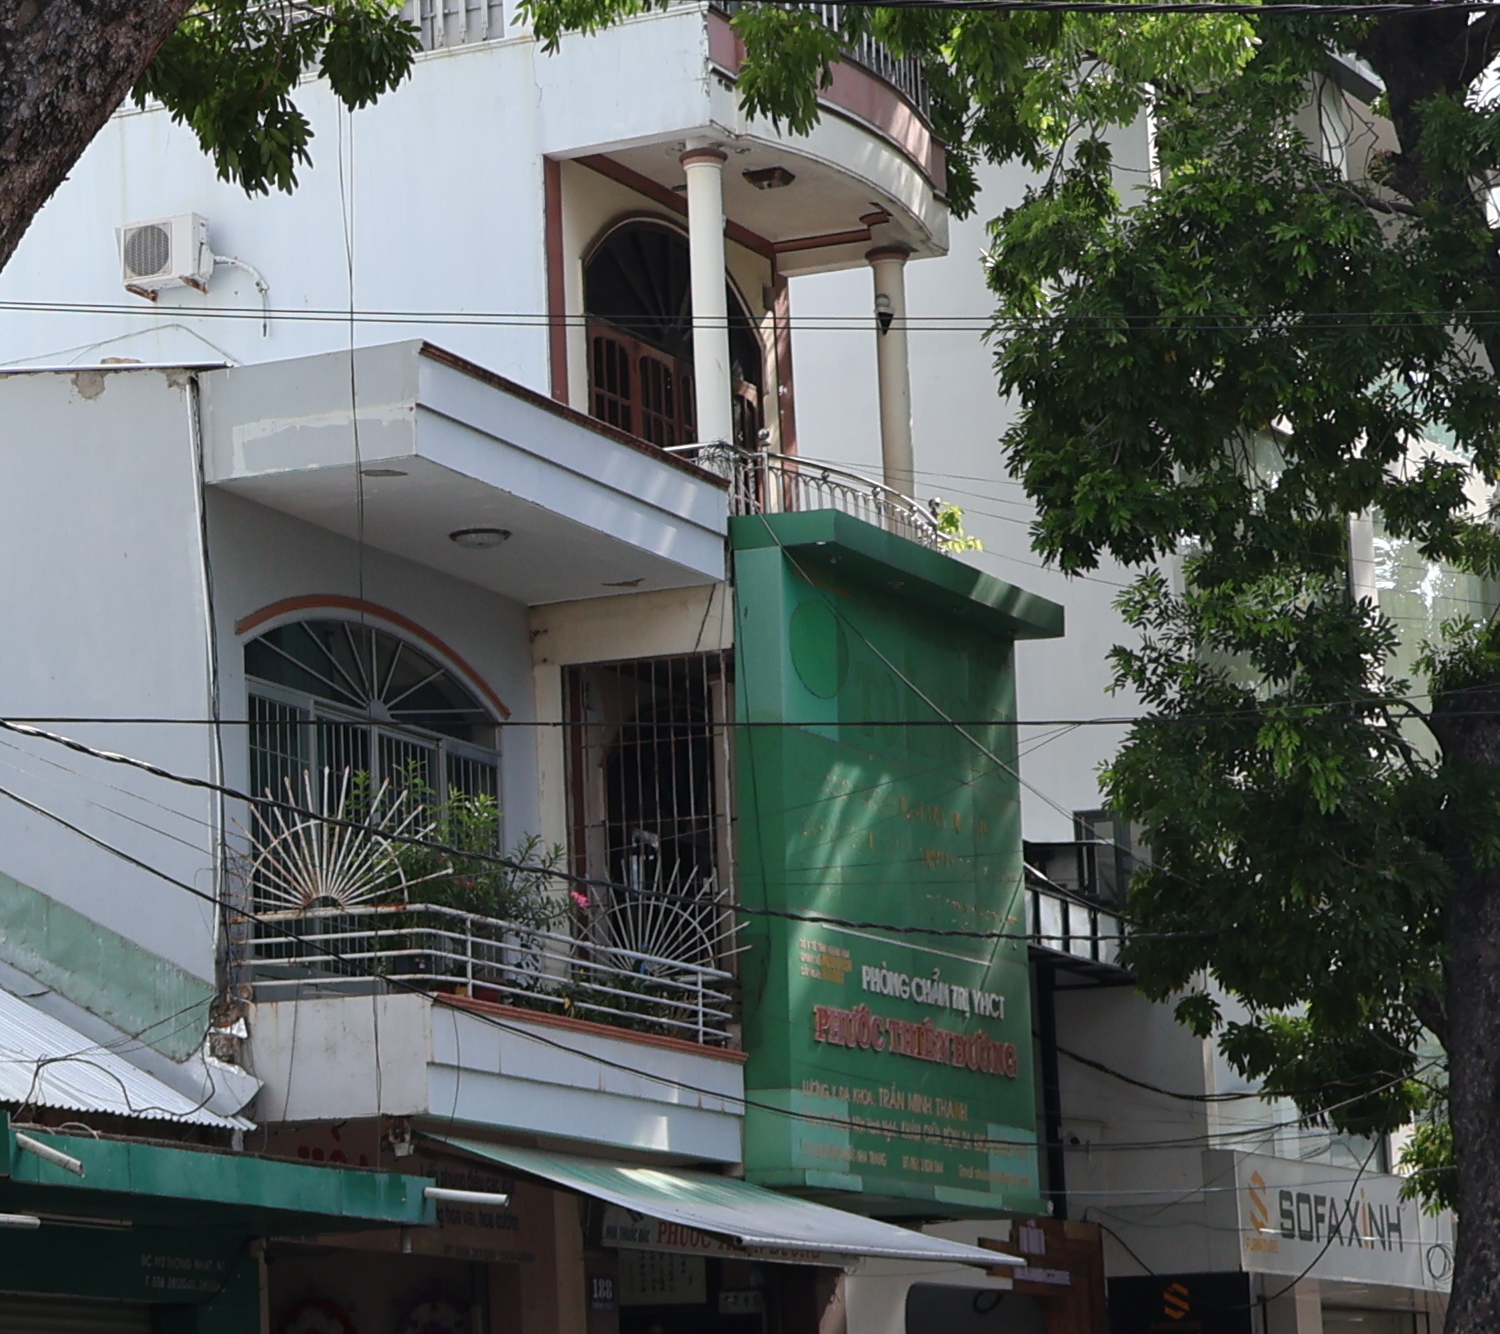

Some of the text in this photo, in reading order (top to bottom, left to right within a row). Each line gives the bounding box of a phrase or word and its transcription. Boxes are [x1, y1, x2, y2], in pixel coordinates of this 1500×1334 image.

[862, 962, 910, 1000] PHÒNG
[972, 989, 1005, 1020] YHCT
[813, 1003, 886, 1052] PHƯỚC
